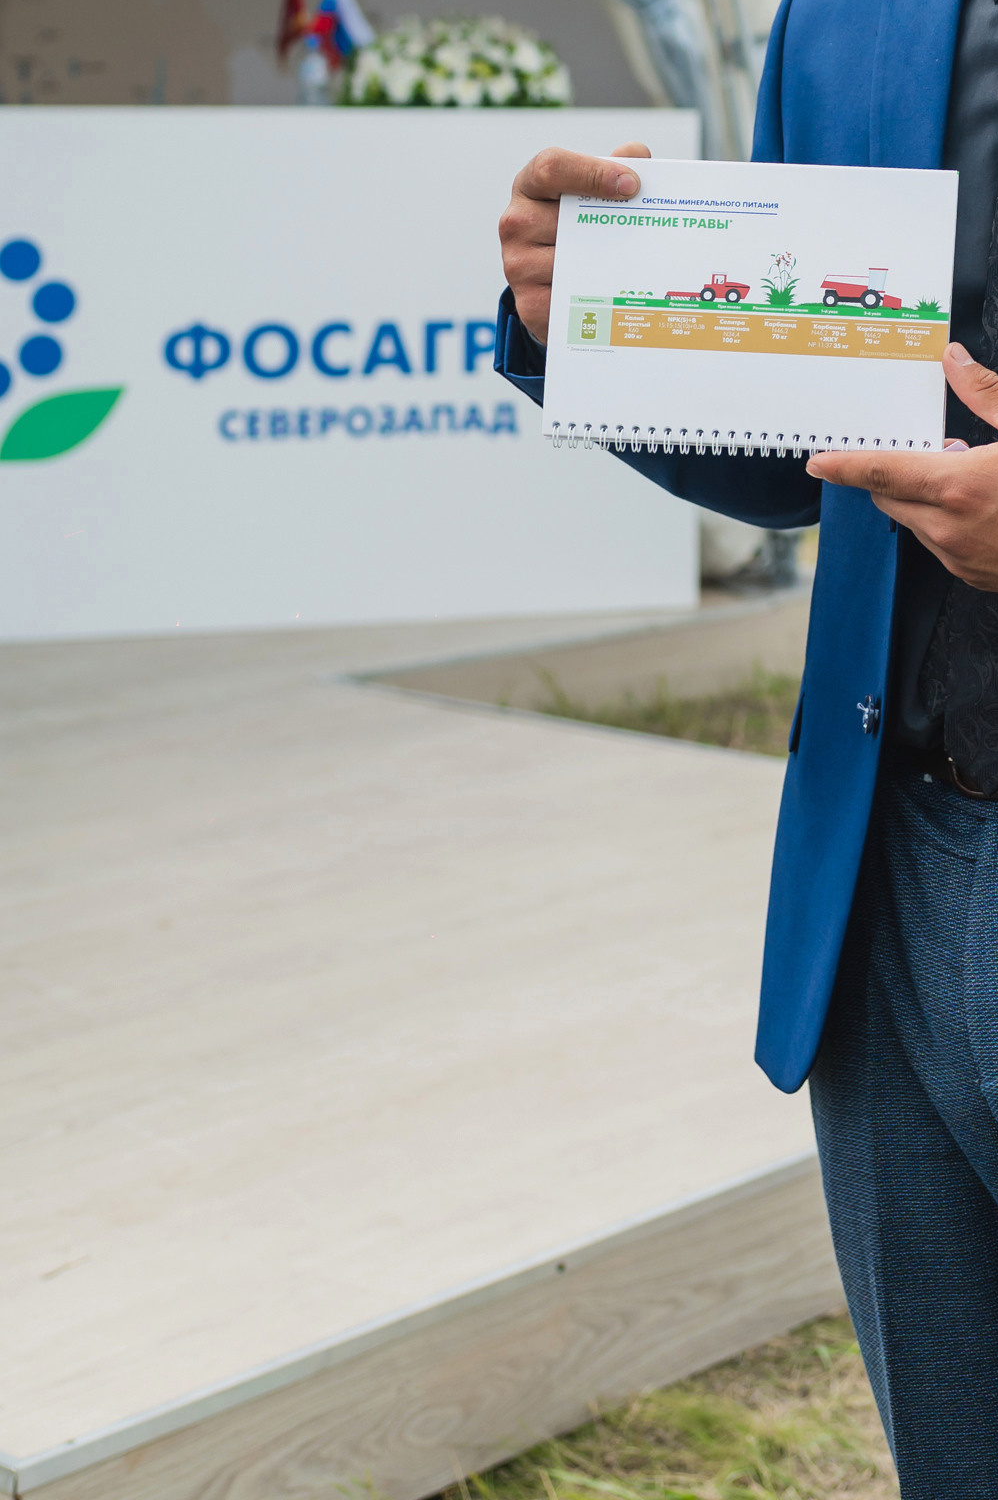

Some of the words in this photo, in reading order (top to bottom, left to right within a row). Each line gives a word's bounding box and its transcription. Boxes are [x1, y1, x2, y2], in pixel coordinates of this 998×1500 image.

[642, 197, 677, 205] СИСТЕМЫ
[678, 199, 741, 208] МИНЕРАЛЬНОГО
[577, 213, 679, 228] МНОГОЛЕТНИЕ
[764, 321, 797, 329] Карбамид
[813, 323, 846, 332] Карбамид
[856, 325, 890, 334] Карбамид
[897, 327, 930, 335] Карбамид
[163, 322, 498, 381] ФОСАГР
[218, 402, 518, 441] СЕВЕРОЗАПАД
